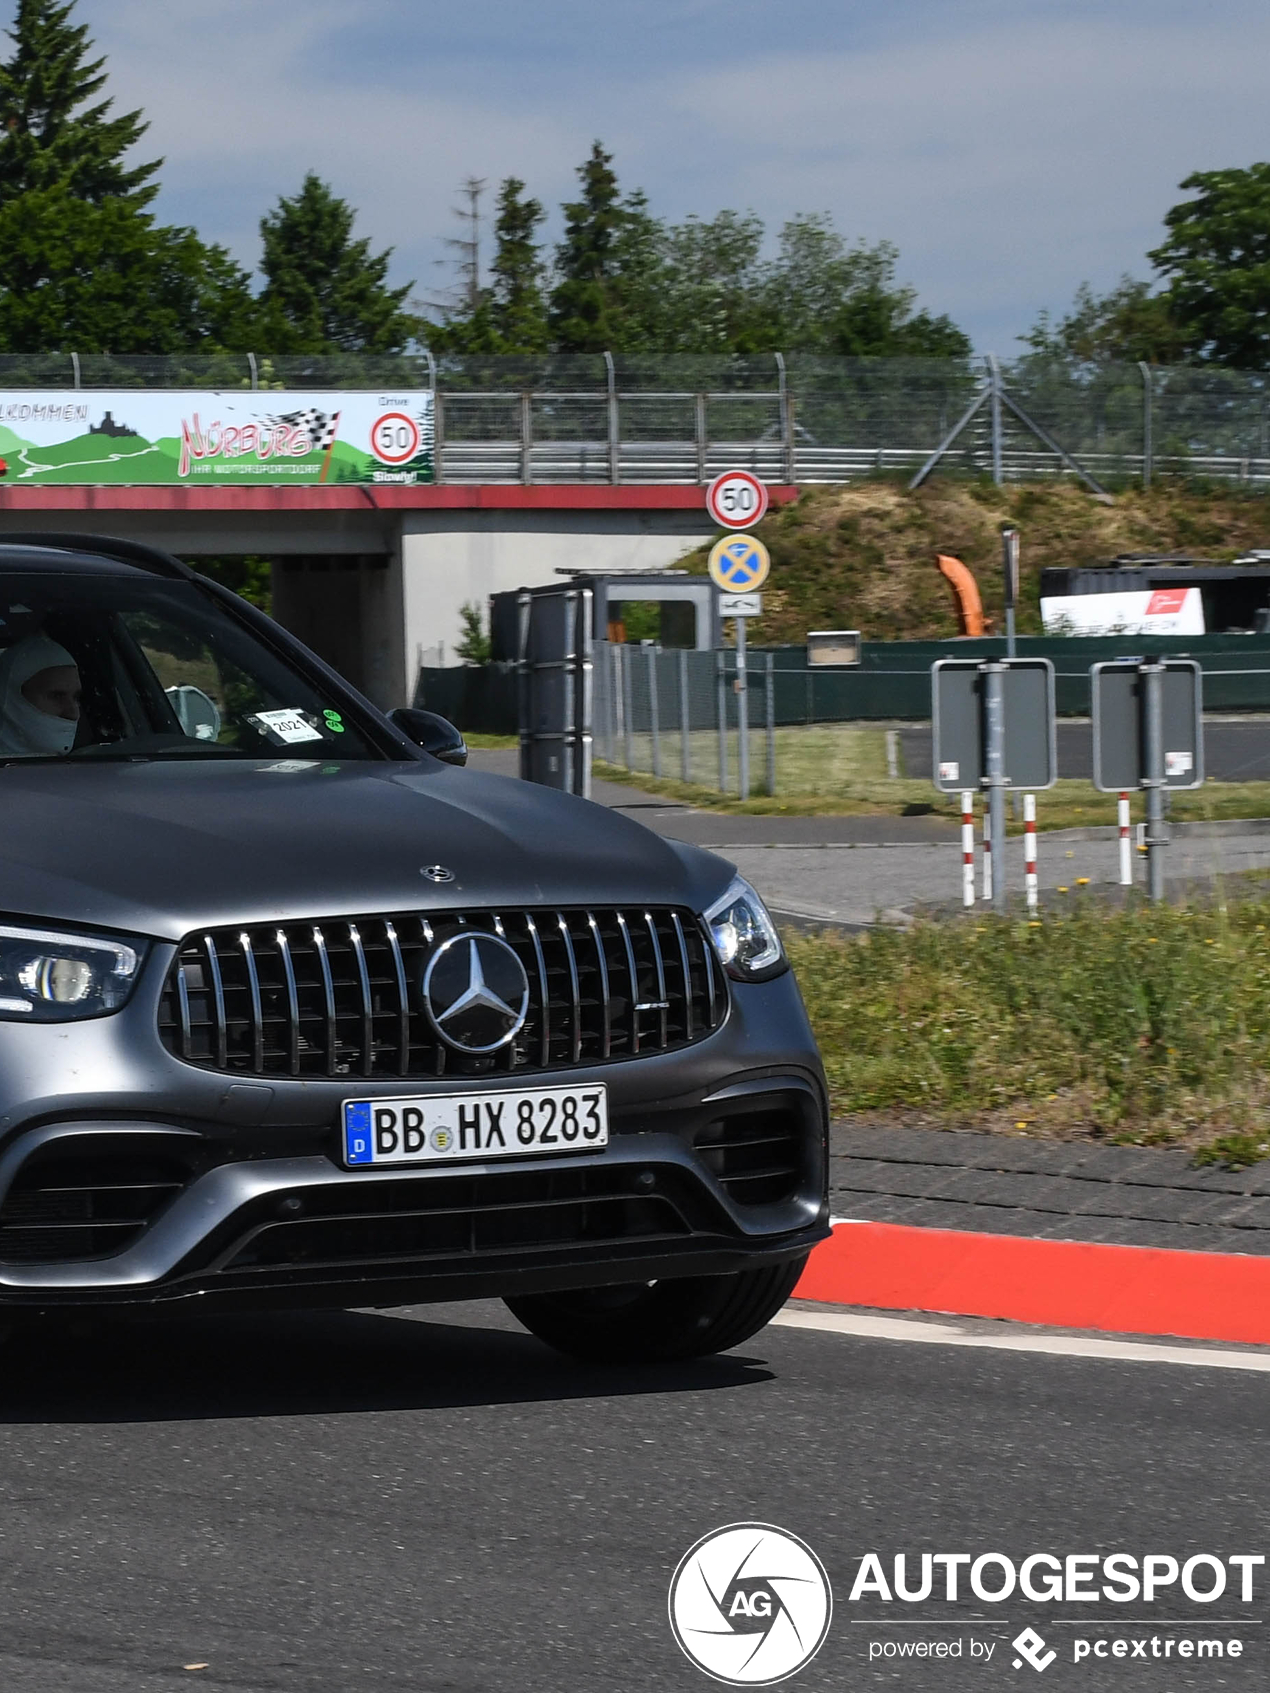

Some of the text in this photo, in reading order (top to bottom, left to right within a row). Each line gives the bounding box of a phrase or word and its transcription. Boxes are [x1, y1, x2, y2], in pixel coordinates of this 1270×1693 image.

[380, 426, 410, 449] 50
[723, 487, 753, 512] 50
[273, 720, 307, 732] 2021
[374, 1094, 602, 1155] BB HX 8283
[353, 1138, 366, 1154] D
